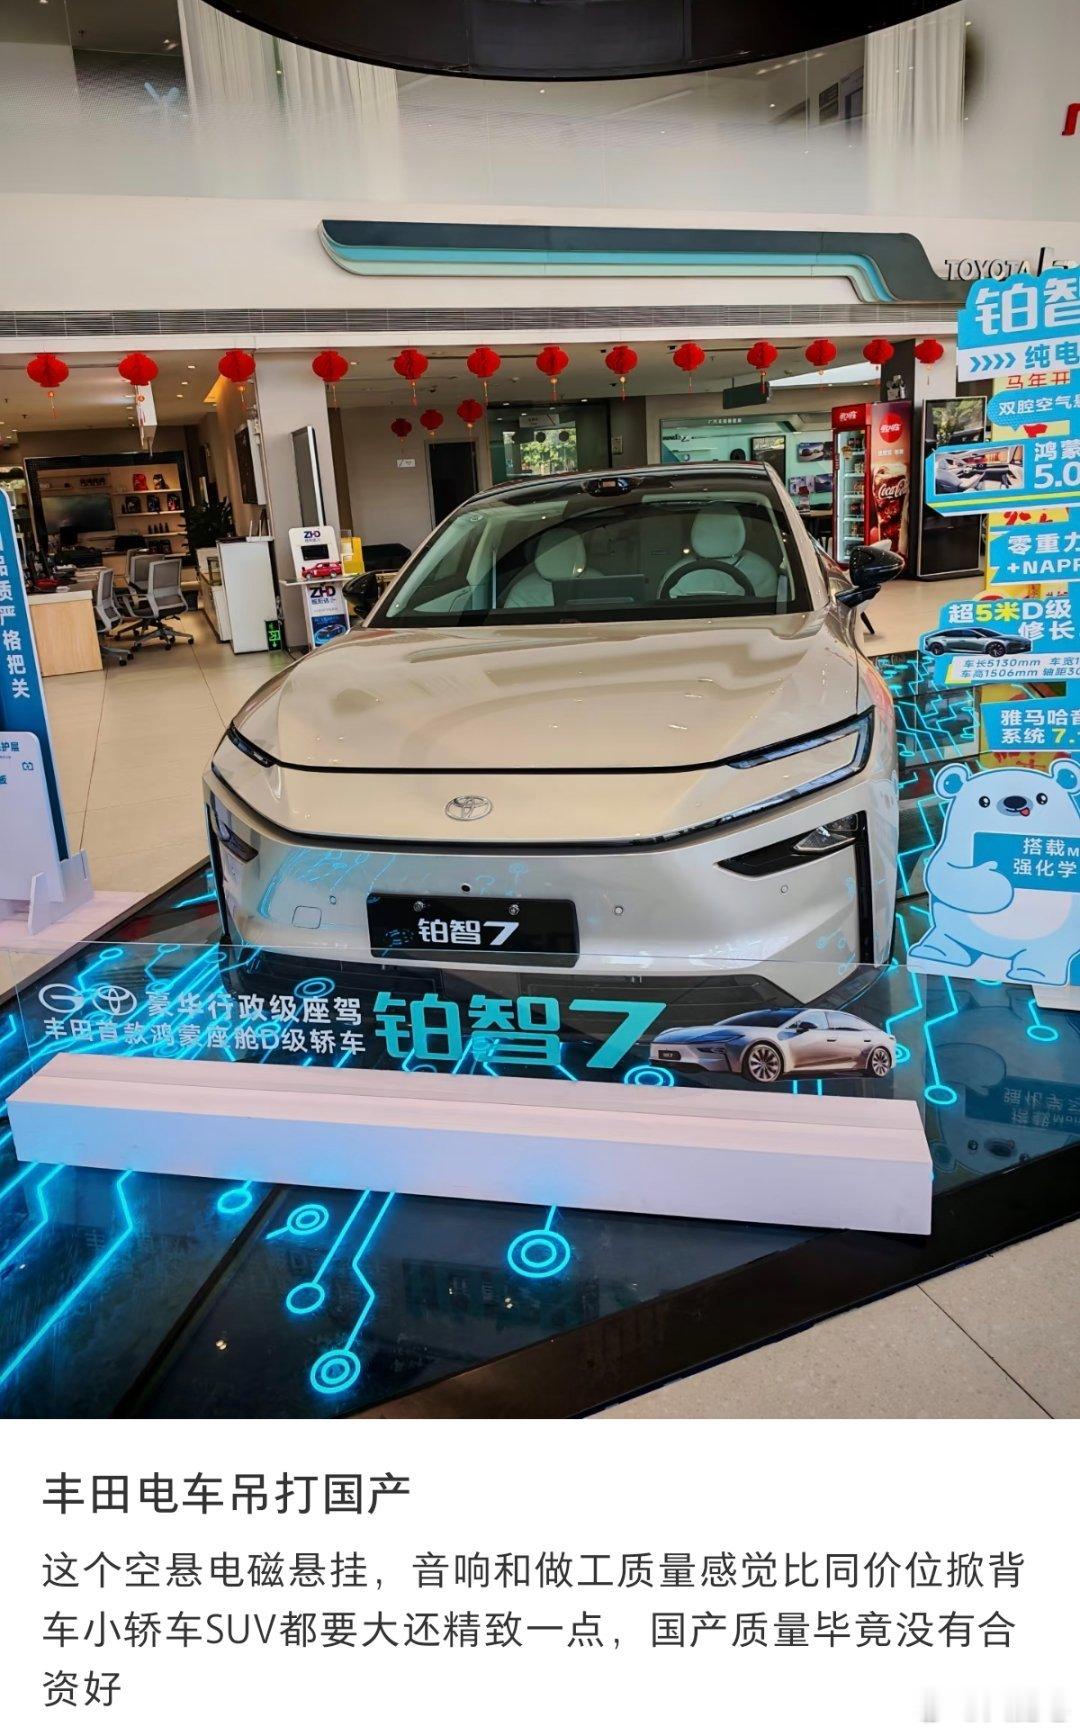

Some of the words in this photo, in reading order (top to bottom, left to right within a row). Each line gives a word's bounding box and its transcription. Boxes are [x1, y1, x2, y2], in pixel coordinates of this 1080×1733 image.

[945, 258, 1032, 281] TOYOTA
[1024, 341, 1080, 369] 纯电
[998, 394, 1080, 416] 双腔空气
[949, 599, 1071, 623] 超5米D级
[1001, 728, 1045, 744] 系统
[1013, 858, 1077, 878] 强化学
[418, 918, 519, 945] 铂智7
[147, 990, 363, 1026] 豪华行政级座驾
[44, 1017, 367, 1055] 丰田首款鸿蒙座舱D级轿车
[373, 991, 667, 1069] 铂智7
